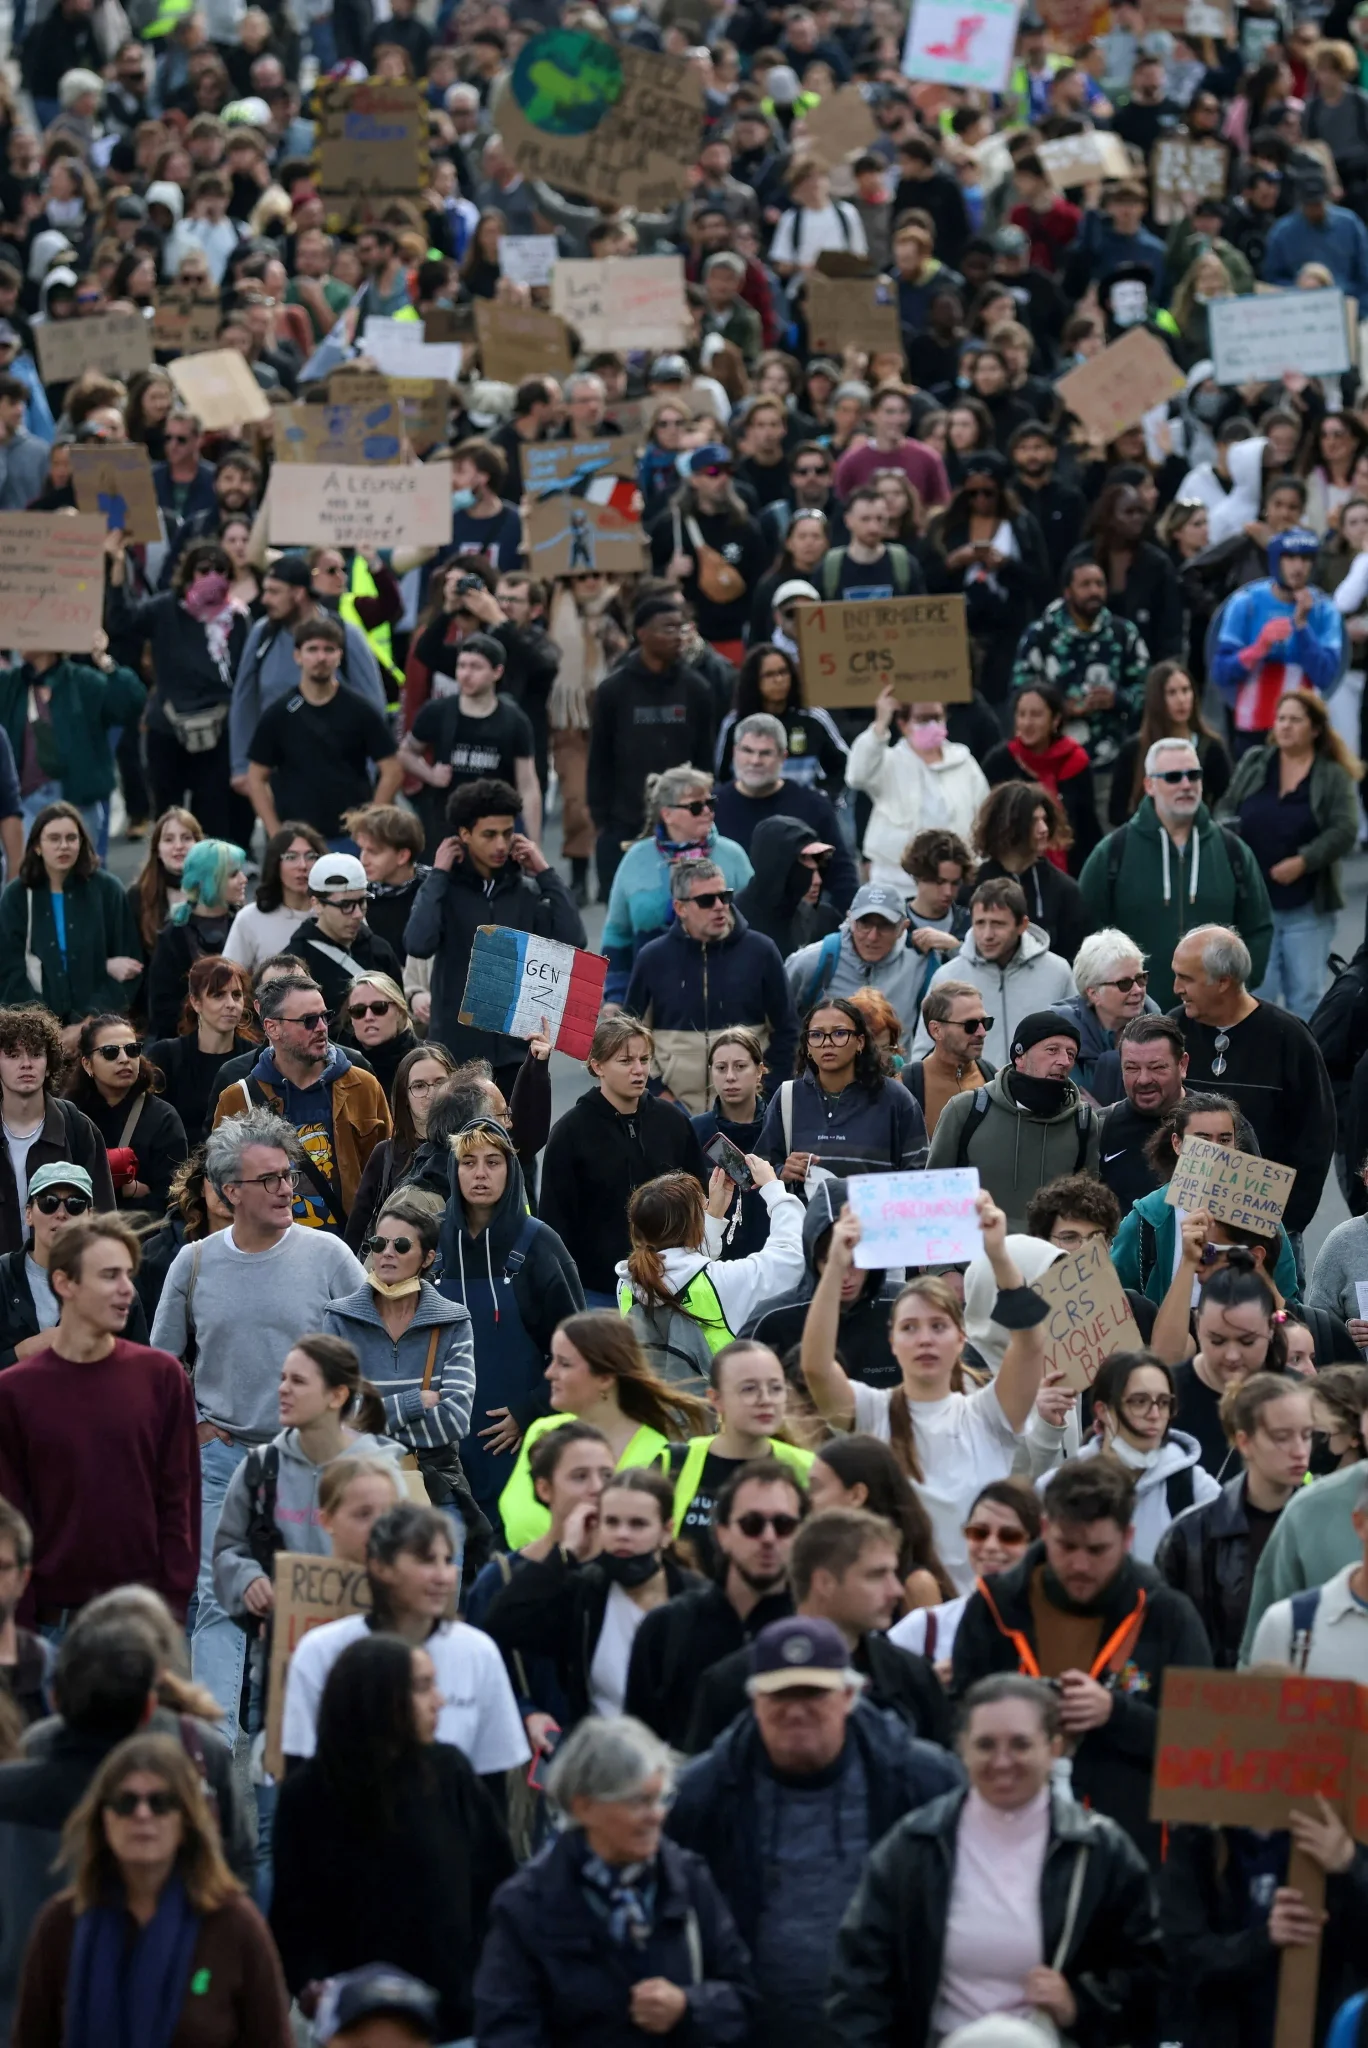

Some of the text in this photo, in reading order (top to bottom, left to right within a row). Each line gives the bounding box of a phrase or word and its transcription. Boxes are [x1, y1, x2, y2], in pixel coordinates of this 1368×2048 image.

[805, 607, 827, 633] 1
[819, 647, 895, 676] 5 CRS
[526, 959, 560, 984] GEN
[530, 985, 555, 1010] Z
[1180, 1140, 1243, 1169] LACRYMO
[1171, 1173, 1283, 1217] POUR LES GRANDS
[1180, 1157, 1272, 1197] BEAU LA VIE
[1177, 1191, 1197, 1208] ET
[1230, 1209, 1280, 1235] PETITS
[926, 1239, 966, 1261] EX
[1050, 1290, 1095, 1340] CRS
[1043, 1297, 1135, 1379] NIQUE LA
[1080, 1341, 1119, 1384] BA
[291, 1562, 373, 1610] RECYC
